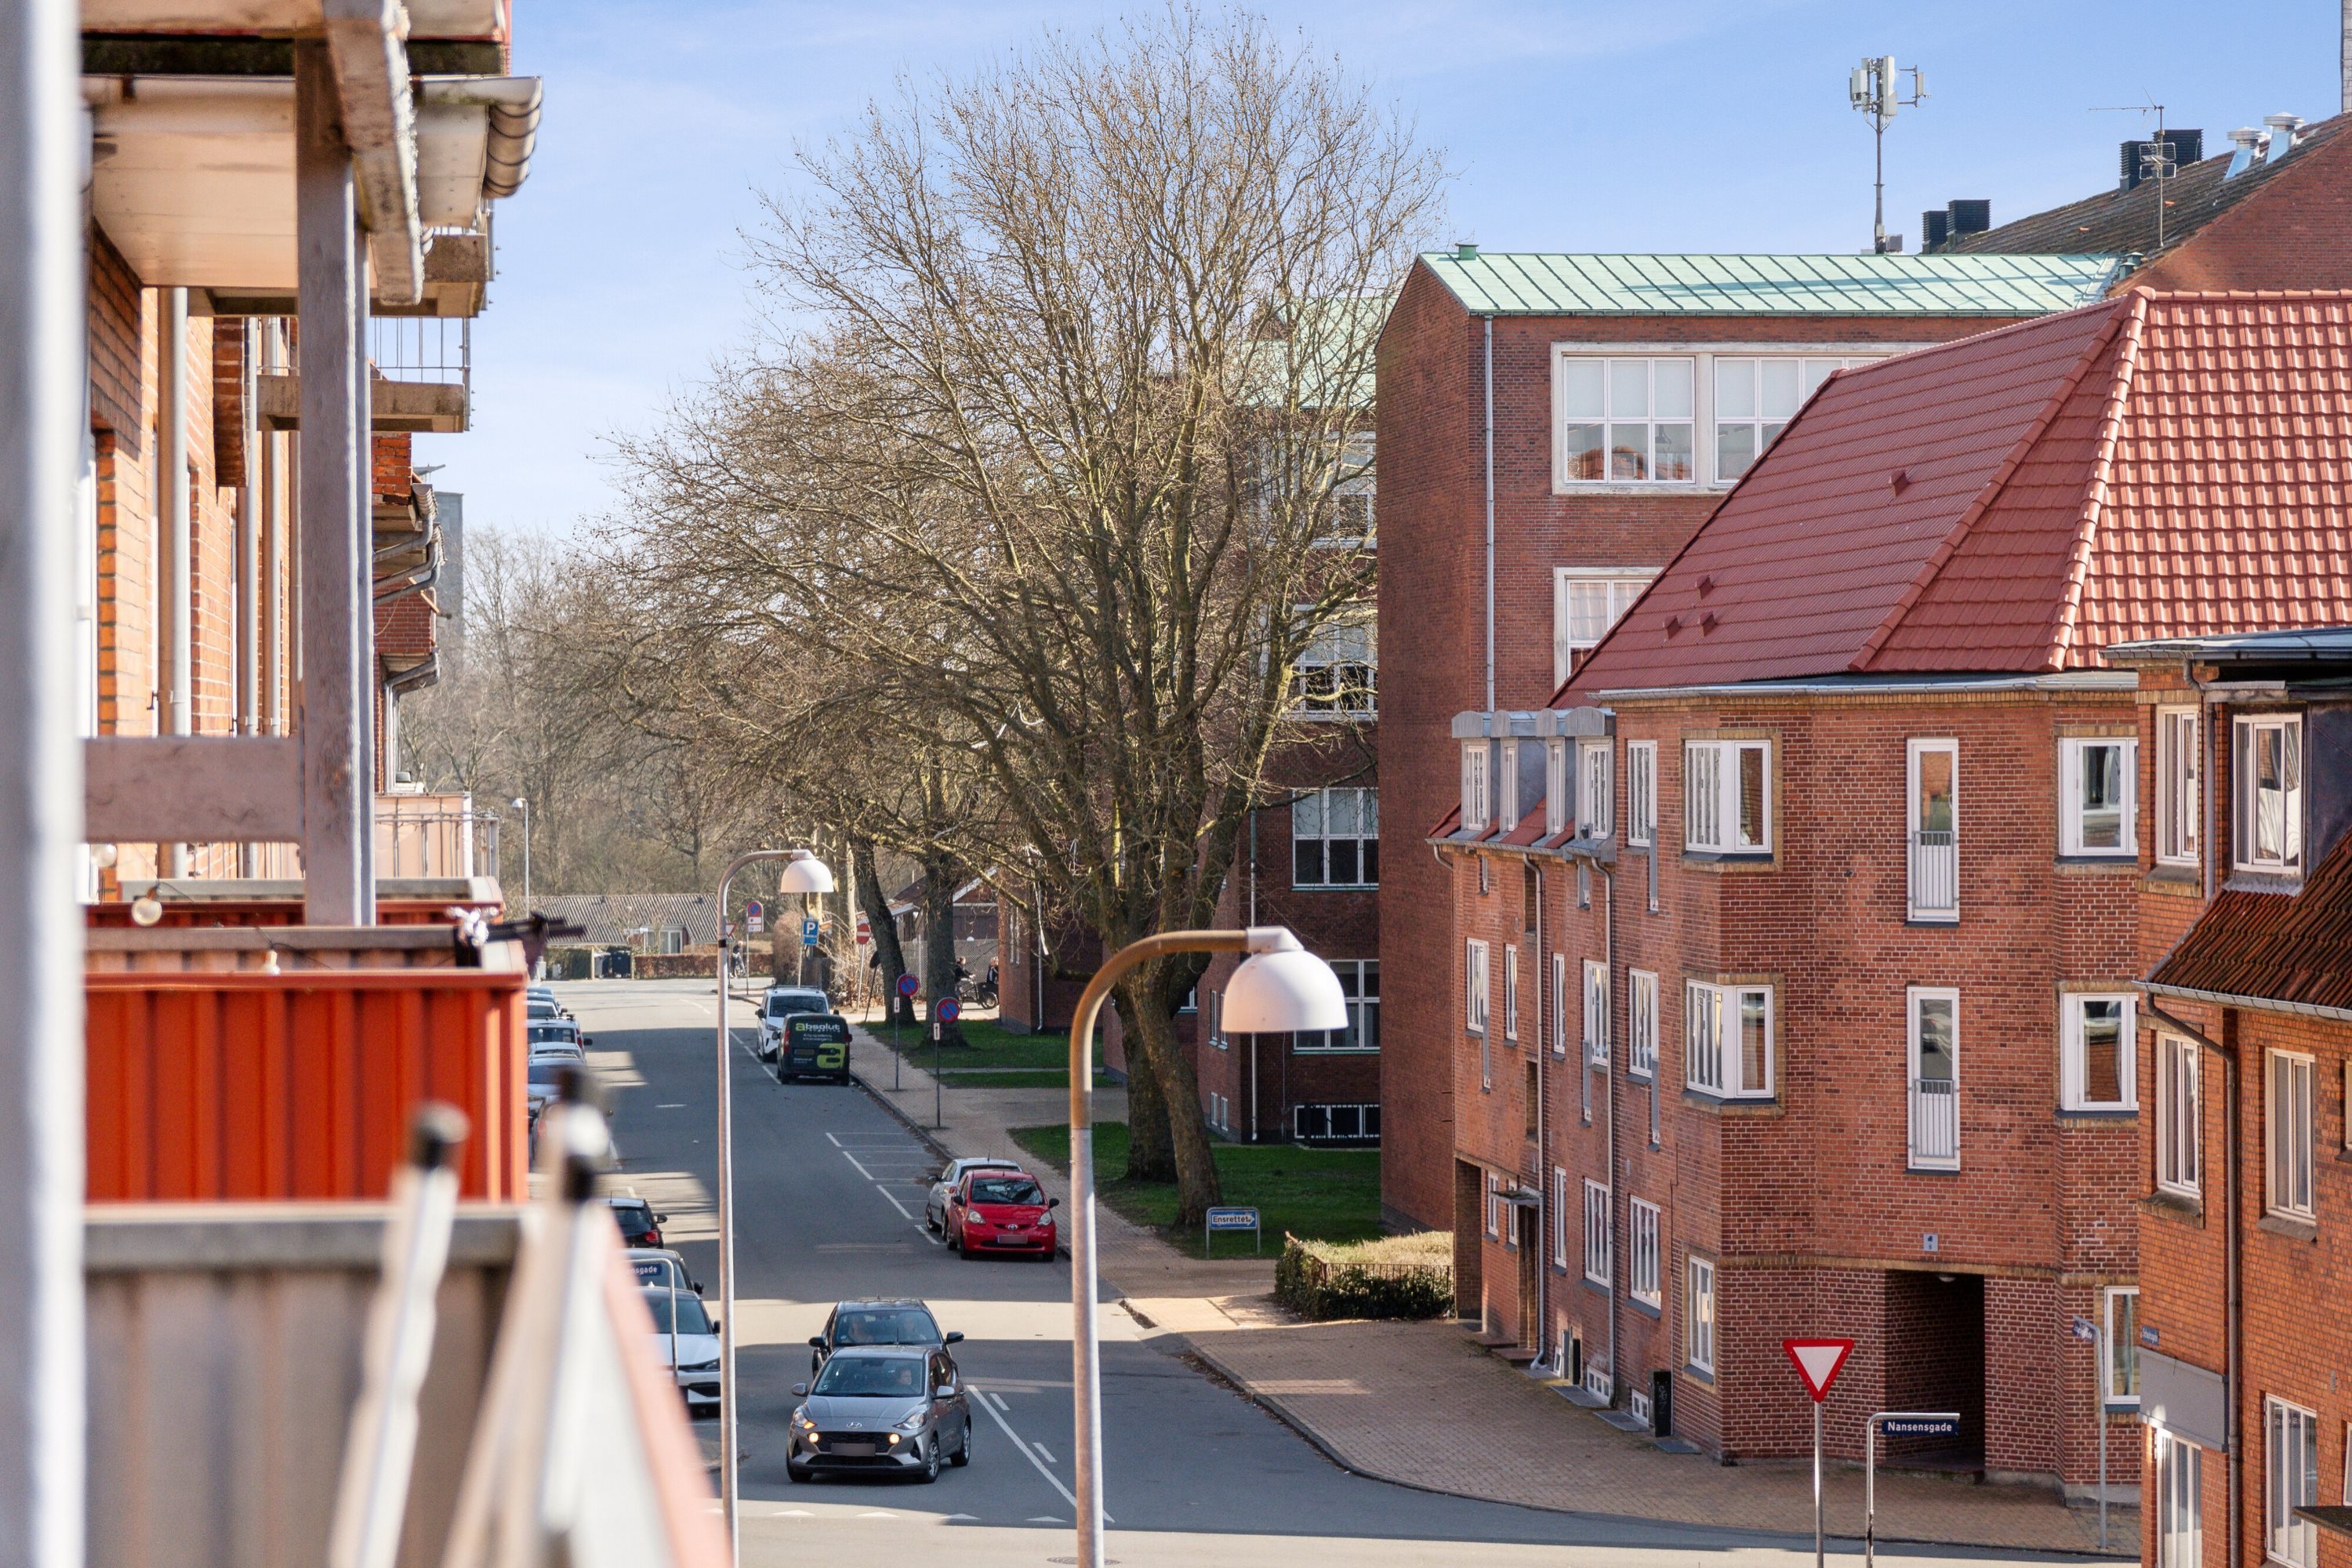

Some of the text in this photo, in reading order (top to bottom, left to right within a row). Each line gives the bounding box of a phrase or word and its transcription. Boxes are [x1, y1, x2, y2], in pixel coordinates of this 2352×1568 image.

[807, 921, 816, 935] P
[795, 1022, 840, 1031] absolut
[1213, 1215, 1250, 1224] Ensrettet
[1887, 1421, 1952, 1433] Nansensgade
